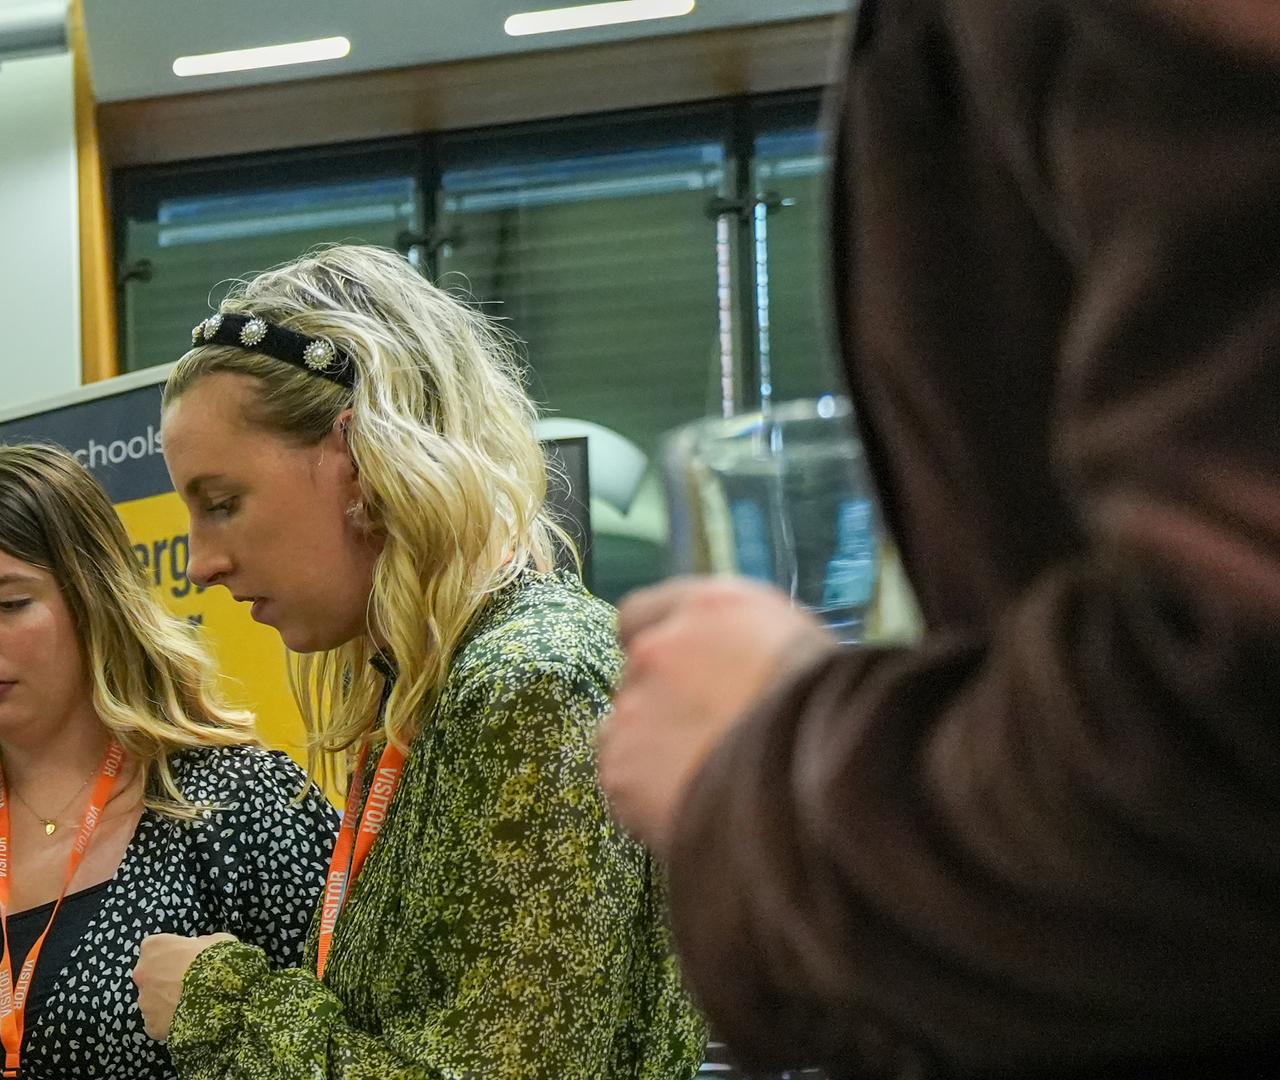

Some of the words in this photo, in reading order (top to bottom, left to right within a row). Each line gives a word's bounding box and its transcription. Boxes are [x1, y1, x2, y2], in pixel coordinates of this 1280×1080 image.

[363, 767, 397, 834] VISITOR
[320, 870, 346, 937] VISITOR
[0, 968, 14, 1018] VISITOR
[14, 959, 36, 1010] VISITOR
